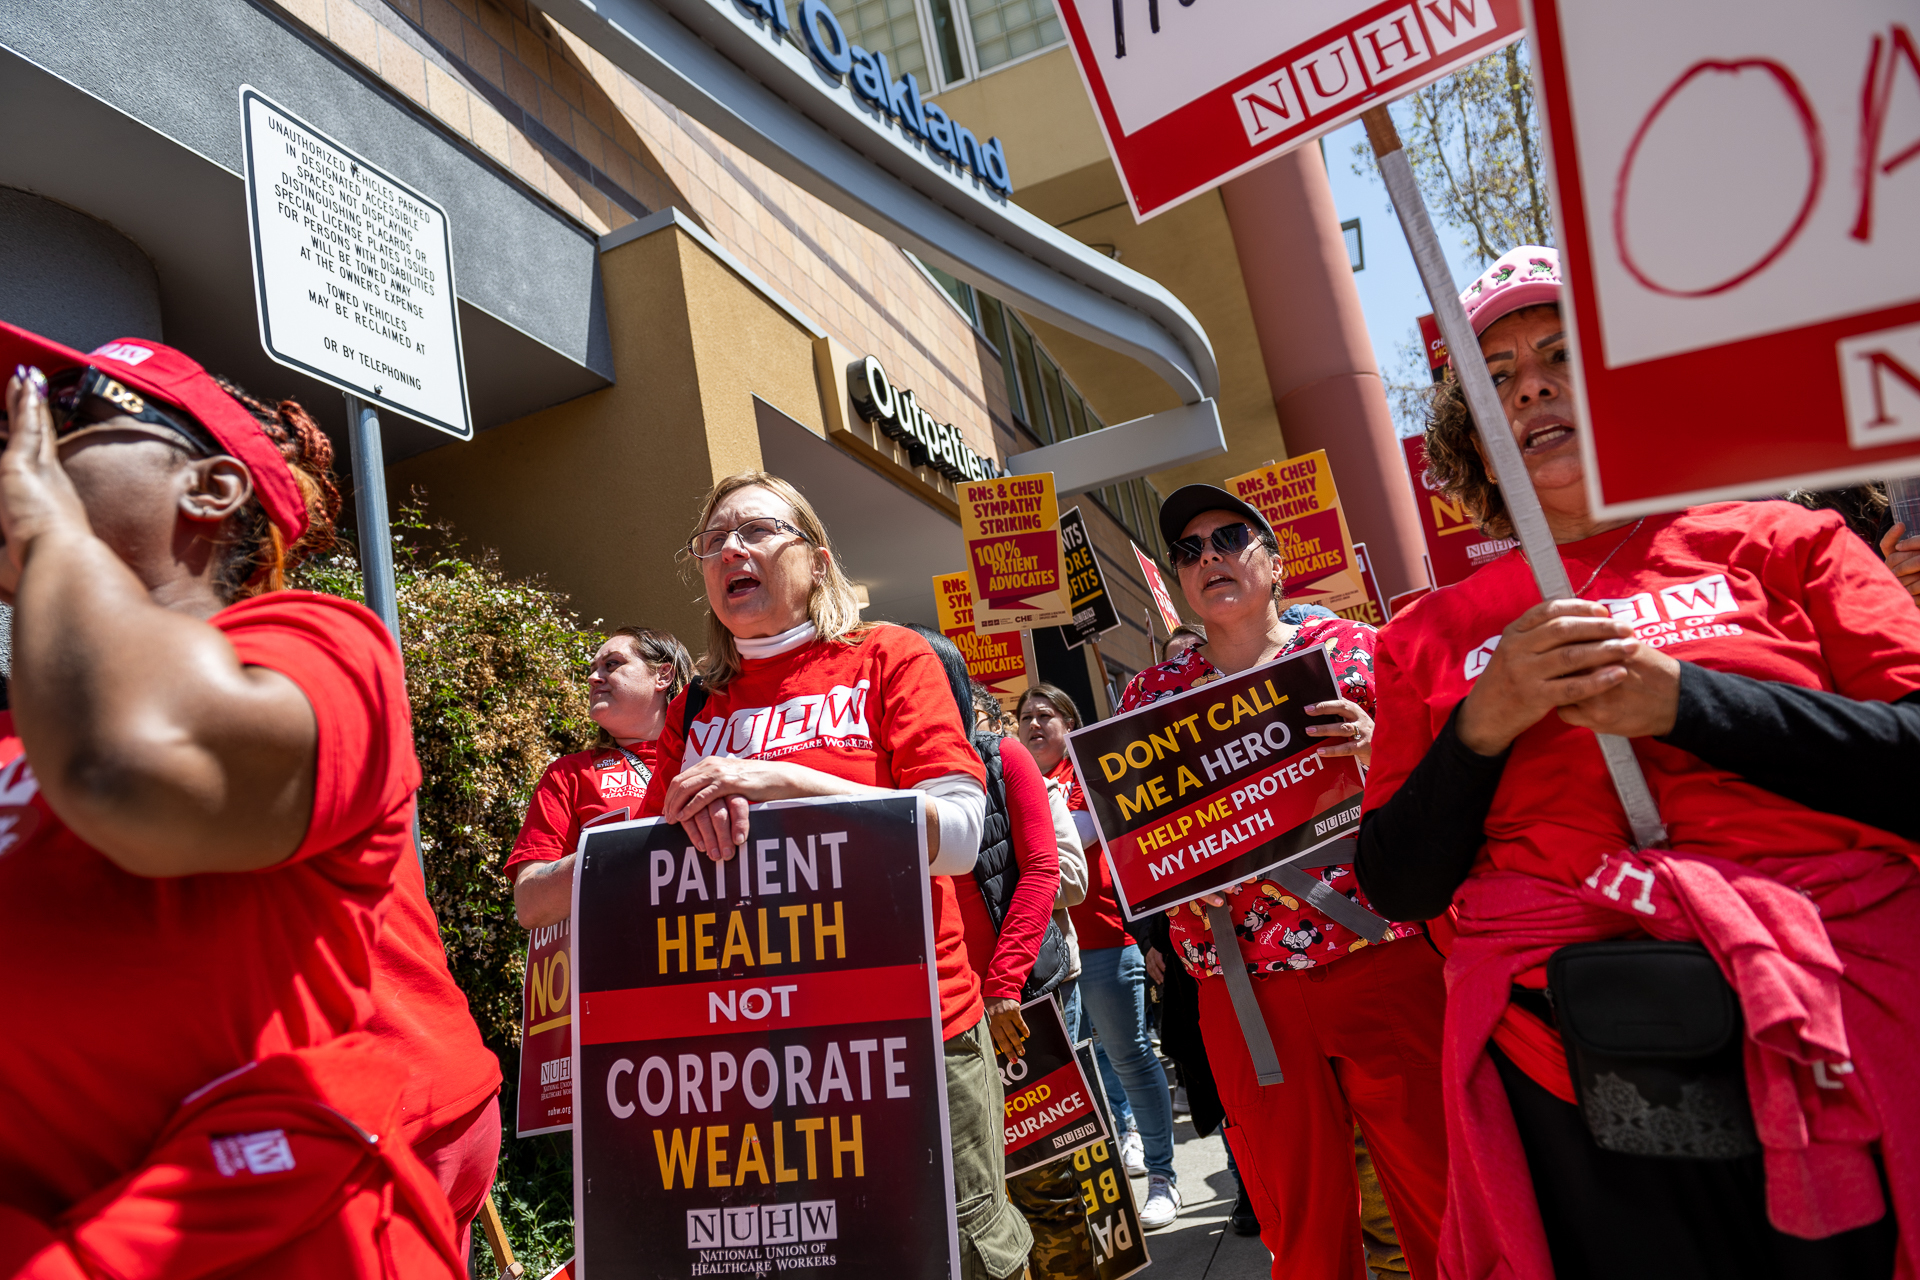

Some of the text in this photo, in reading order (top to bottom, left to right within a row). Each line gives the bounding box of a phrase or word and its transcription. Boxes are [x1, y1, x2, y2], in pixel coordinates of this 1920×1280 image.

[1241, 0, 1480, 136] NUHW
[799, 0, 1013, 197] Oakland
[268, 115, 346, 173] UNAUTHORIZED
[398, 196, 430, 224] PARKED
[286, 142, 420, 232] IN DESIGNATED ACCESSIBLE
[282, 172, 427, 264] DISTINGUISHING PLACARDS OR
[297, 165, 413, 242] SPACES NOT DISPLAYING
[275, 184, 435, 282] SPECIAL LICENSE PLATES ISSUED
[278, 201, 435, 296] FOR PERSONS WITH DISABILITIES
[300, 246, 424, 319] AT THE OWNER'S EXPENSE
[310, 235, 411, 298] WILL BE TOWED AWAY
[308, 289, 425, 355] MAY BE RECLAIMED AT
[326, 282, 407, 332] TOWED VEHICLES
[324, 336, 421, 391] OR BY TELEPHONING
[862, 354, 1000, 482] Outpatient
[968, 479, 1044, 502] RNs & CHEU
[1236, 459, 1317, 497] RNs & CHEU
[973, 496, 1042, 519] SYMPATHY
[979, 514, 1042, 536] STRIKING
[975, 539, 1022, 567] 100%
[992, 555, 1038, 575] PATIENT
[1065, 546, 1092, 575] ORE
[942, 578, 967, 594] RNs
[989, 570, 1055, 592] ADVOCATES
[1640, 623, 1744, 648] ORKERS
[1685, 615, 1717, 627] OF
[965, 642, 1009, 661] PATIENT
[682, 687, 868, 763] NUHW
[825, 736, 873, 750] WORKERS
[1098, 679, 1289, 783] DON'T CALL
[1115, 775, 1172, 821] ME
[1177, 765, 1203, 797] A
[1200, 721, 1291, 782] HERO
[1136, 752, 1325, 856] HELP ME PROTECT
[1316, 805, 1360, 836] NUHW
[1148, 808, 1275, 882] MY HEALTH
[657, 901, 846, 975] HEALTH
[530, 947, 571, 1021] NO
[708, 985, 798, 1023] NOT
[606, 1037, 911, 1119] CORPORATE
[548, 1106, 571, 1116] nuhw.org
[1004, 1091, 1085, 1146] SURANCE
[1053, 1123, 1096, 1148] NUHW
[653, 1115, 865, 1191] WEALTH
[690, 1205, 834, 1243] NUHW
[691, 1255, 837, 1276] HEALTHCARE WORKERS
[700, 1243, 827, 1263] NATIONAL UNION OF
